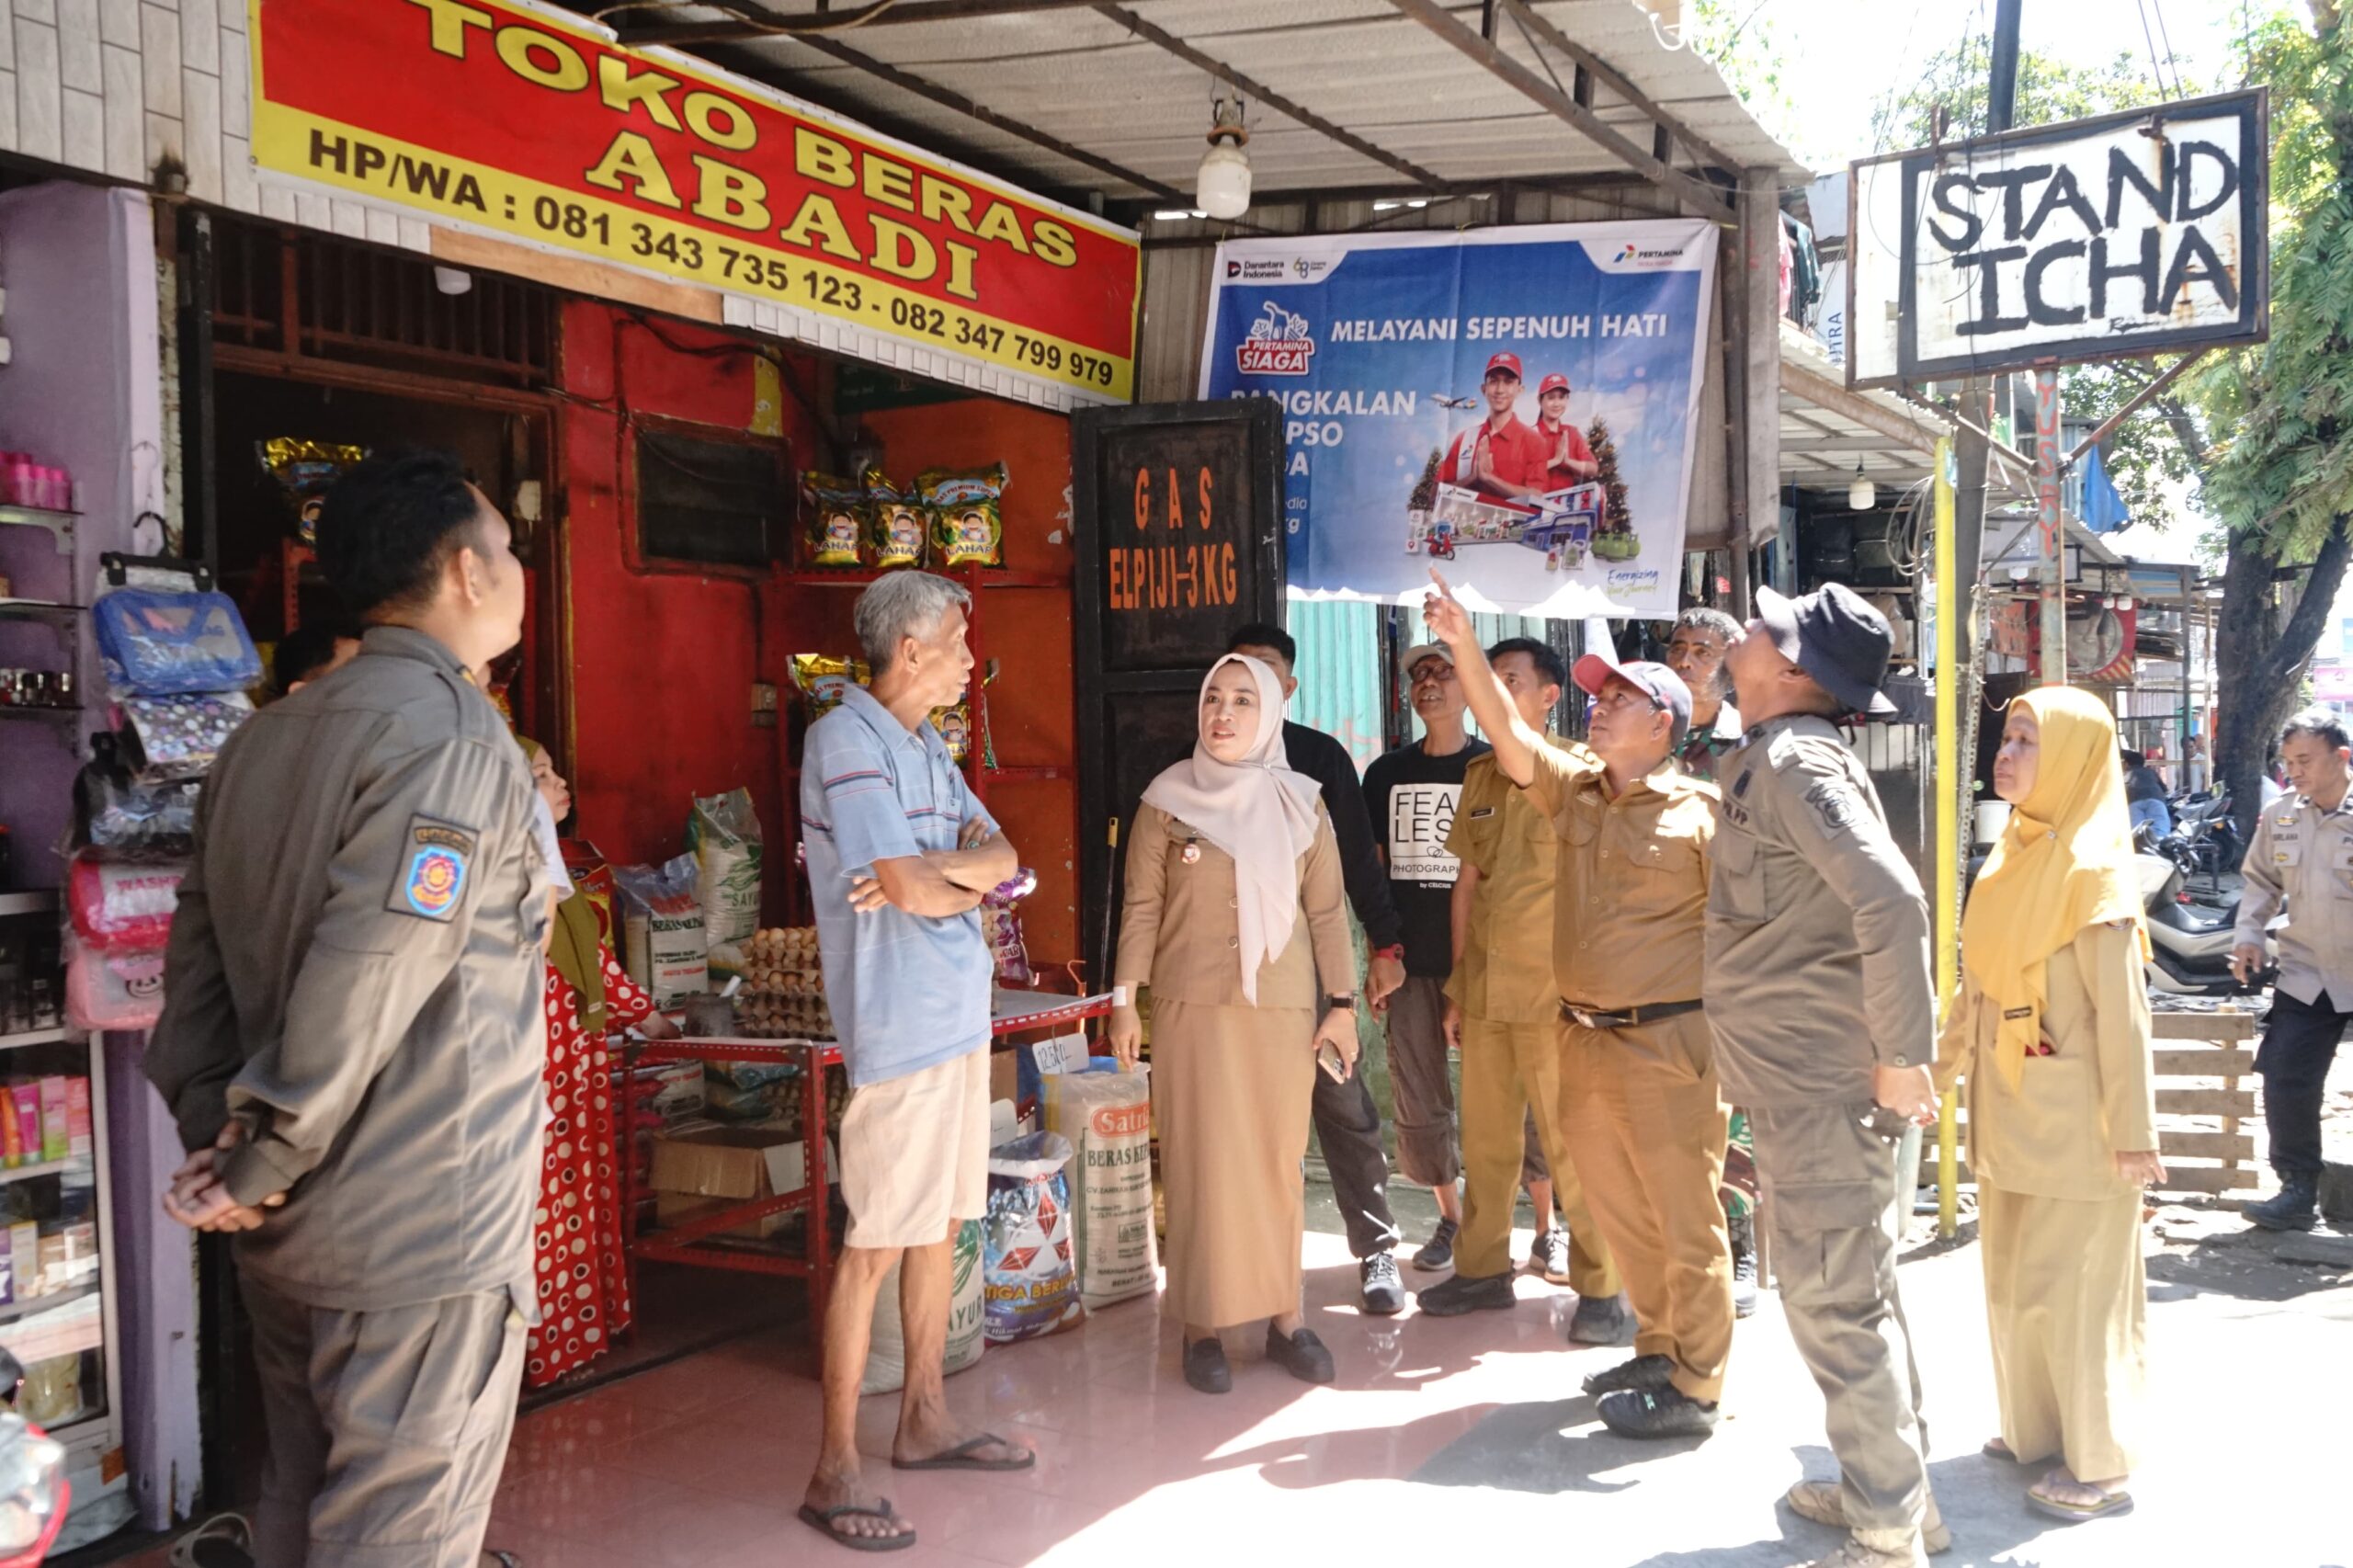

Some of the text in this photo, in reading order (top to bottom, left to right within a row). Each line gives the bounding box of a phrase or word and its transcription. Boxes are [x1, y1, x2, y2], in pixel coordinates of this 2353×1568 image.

[404, 0, 1078, 267] TOKO BERAS
[1927, 140, 2241, 252] STAND
[585, 130, 978, 301] ABADI
[308, 128, 488, 214] HP/WA
[533, 195, 611, 247] 081
[631, 222, 705, 270] 343
[717, 245, 789, 291] 735
[802, 269, 862, 312] 123
[890, 298, 947, 337] 082
[954, 315, 1006, 354] 347
[1014, 334, 1063, 371] 799
[1069, 351, 1114, 387] 979
[1638, 249, 1684, 258] PERTAMINA
[1243, 269, 1284, 278] Indonesia
[1244, 261, 1285, 270] Danantara
[1952, 225, 2238, 336] ICHA
[1330, 313, 1667, 342] MELAYANI SEPENUH HATI
[1253, 341, 1310, 352] PERTAMINA
[1242, 351, 1303, 370] SIAGA
[947, 544, 994, 556] LAHAP
[1395, 791, 1456, 816] FEA
[1087, 1148, 1131, 1167] BERAS
